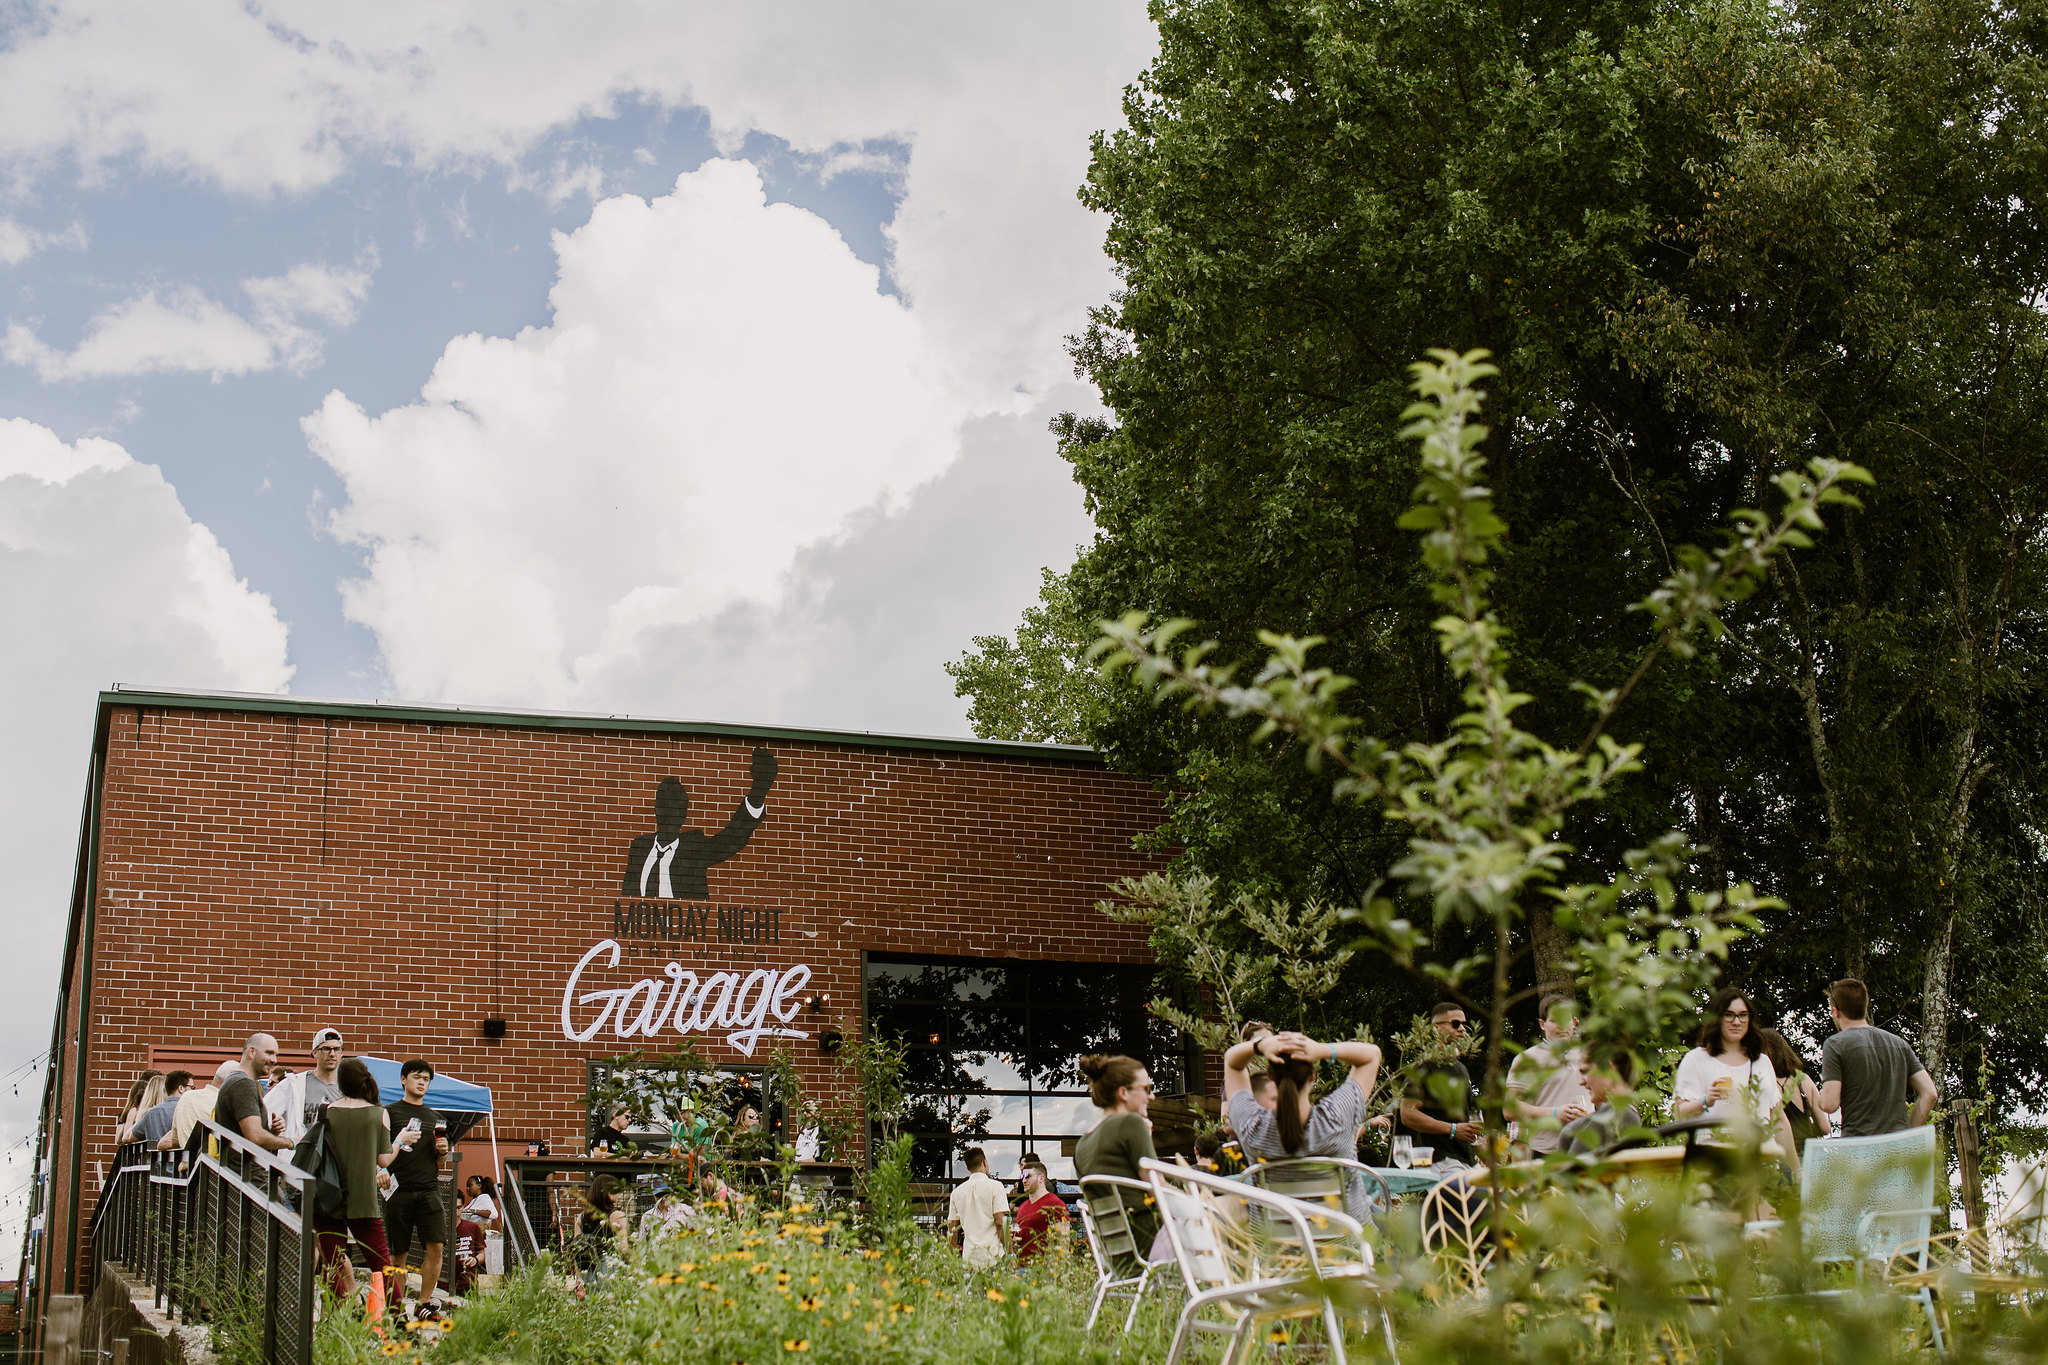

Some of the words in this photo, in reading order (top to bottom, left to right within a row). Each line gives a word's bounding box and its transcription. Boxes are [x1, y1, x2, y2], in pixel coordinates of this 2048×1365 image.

[614, 901, 711, 941] MONDAY
[717, 906, 782, 944] NIGHT
[628, 945, 766, 962] BREWING
[561, 939, 811, 1057] Garage
